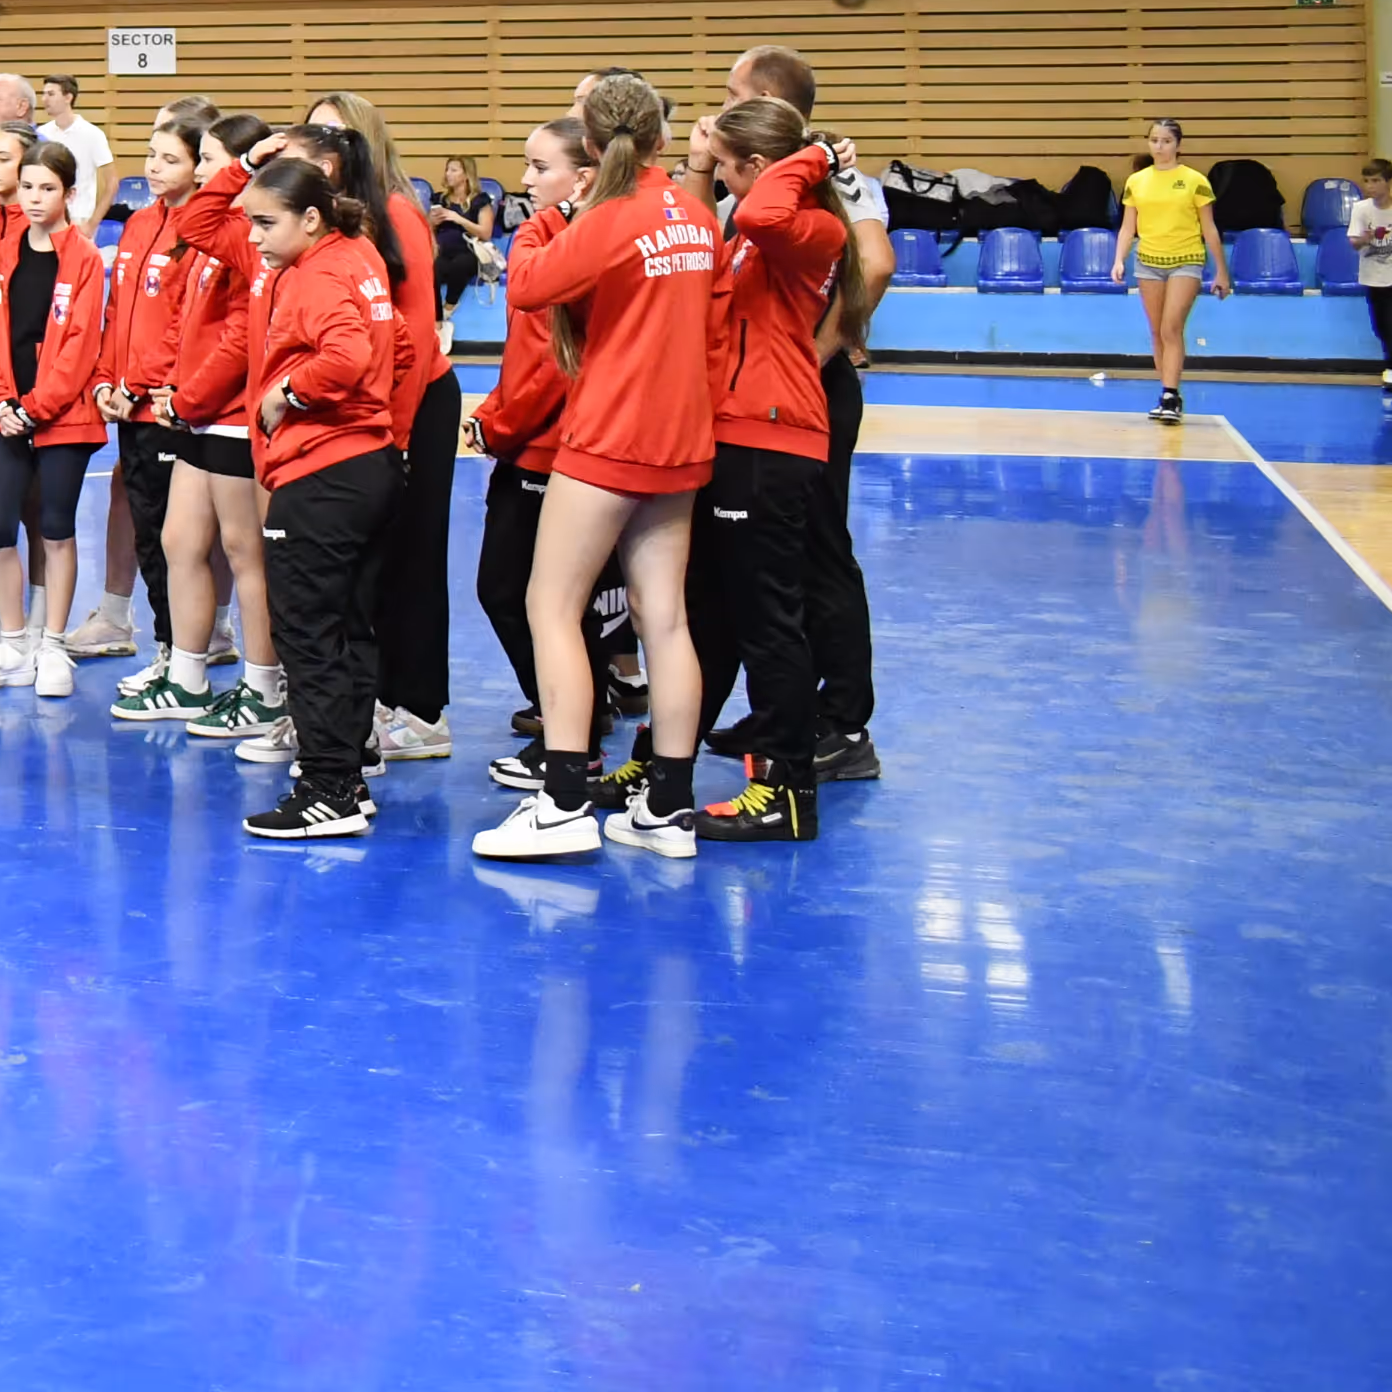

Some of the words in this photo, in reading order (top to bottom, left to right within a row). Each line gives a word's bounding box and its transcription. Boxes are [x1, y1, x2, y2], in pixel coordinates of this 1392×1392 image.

[111, 33, 173, 46] SECTOR
[138, 53, 148, 69] 8
[645, 256, 671, 277] CSS
[714, 506, 748, 521] Kempa
